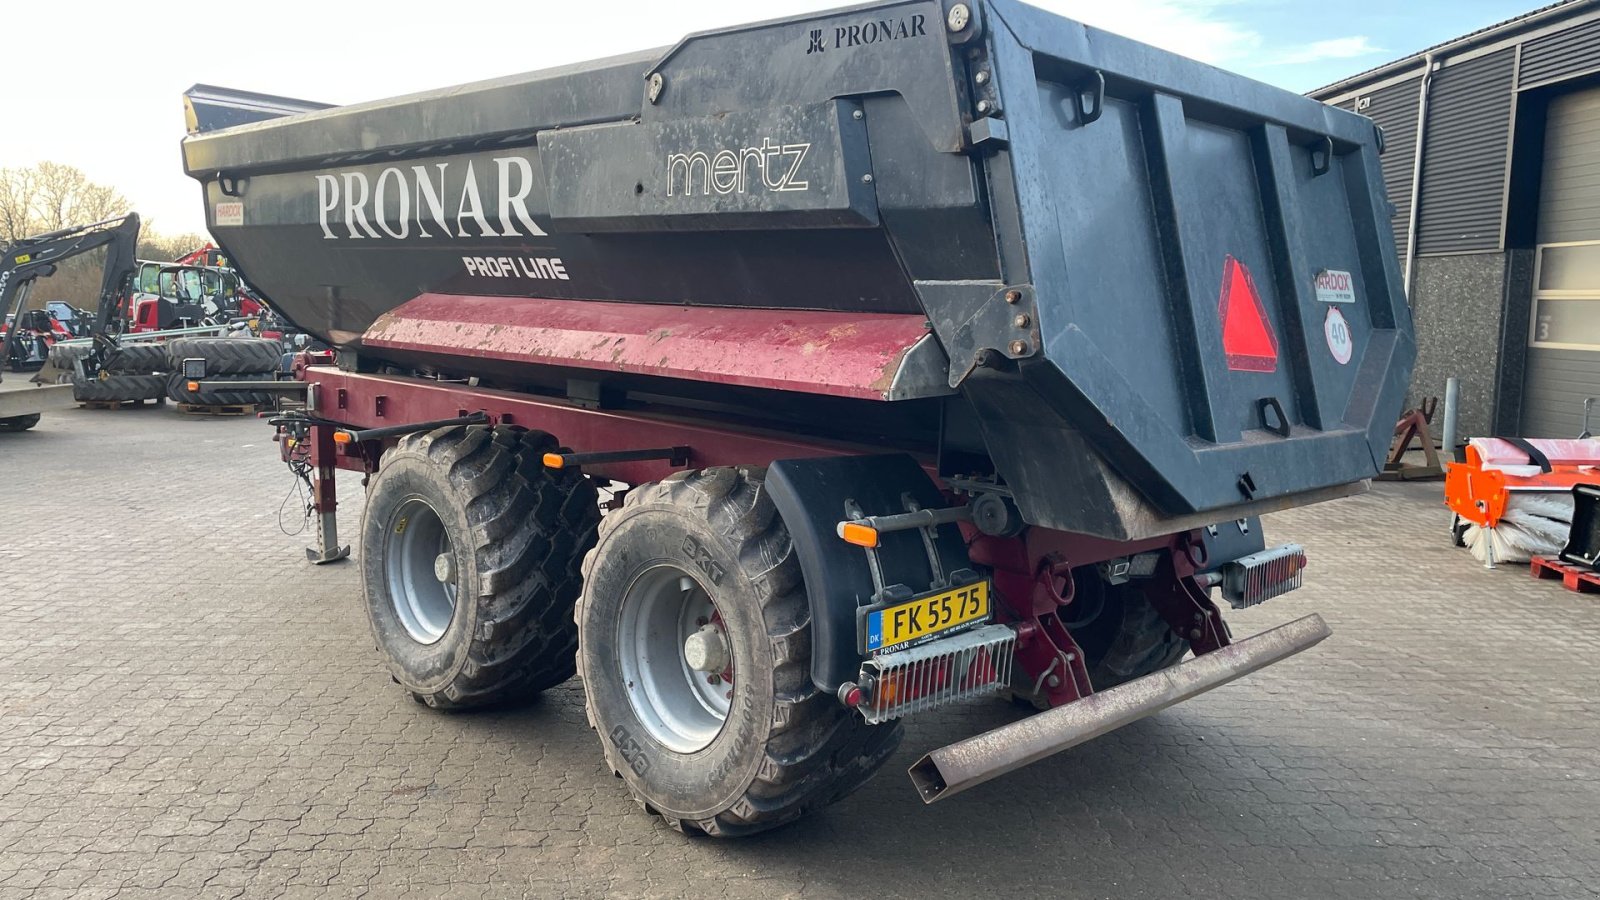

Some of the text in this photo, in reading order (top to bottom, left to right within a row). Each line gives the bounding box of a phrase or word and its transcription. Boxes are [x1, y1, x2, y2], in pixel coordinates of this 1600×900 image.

[835, 14, 926, 49] PRONAR
[667, 137, 811, 197] mertz
[315, 156, 548, 240] PRONAR
[462, 256, 570, 281] PROFI LINE
[1331, 323, 1346, 345] 40
[1540, 322, 1549, 340] 3
[682, 535, 726, 586] BKT
[894, 605, 923, 638] FK
[928, 596, 952, 628] 55
[957, 587, 980, 619] 75
[869, 634, 880, 644] DK
[880, 641, 910, 656] PRONAR
[609, 725, 651, 777] BKT
